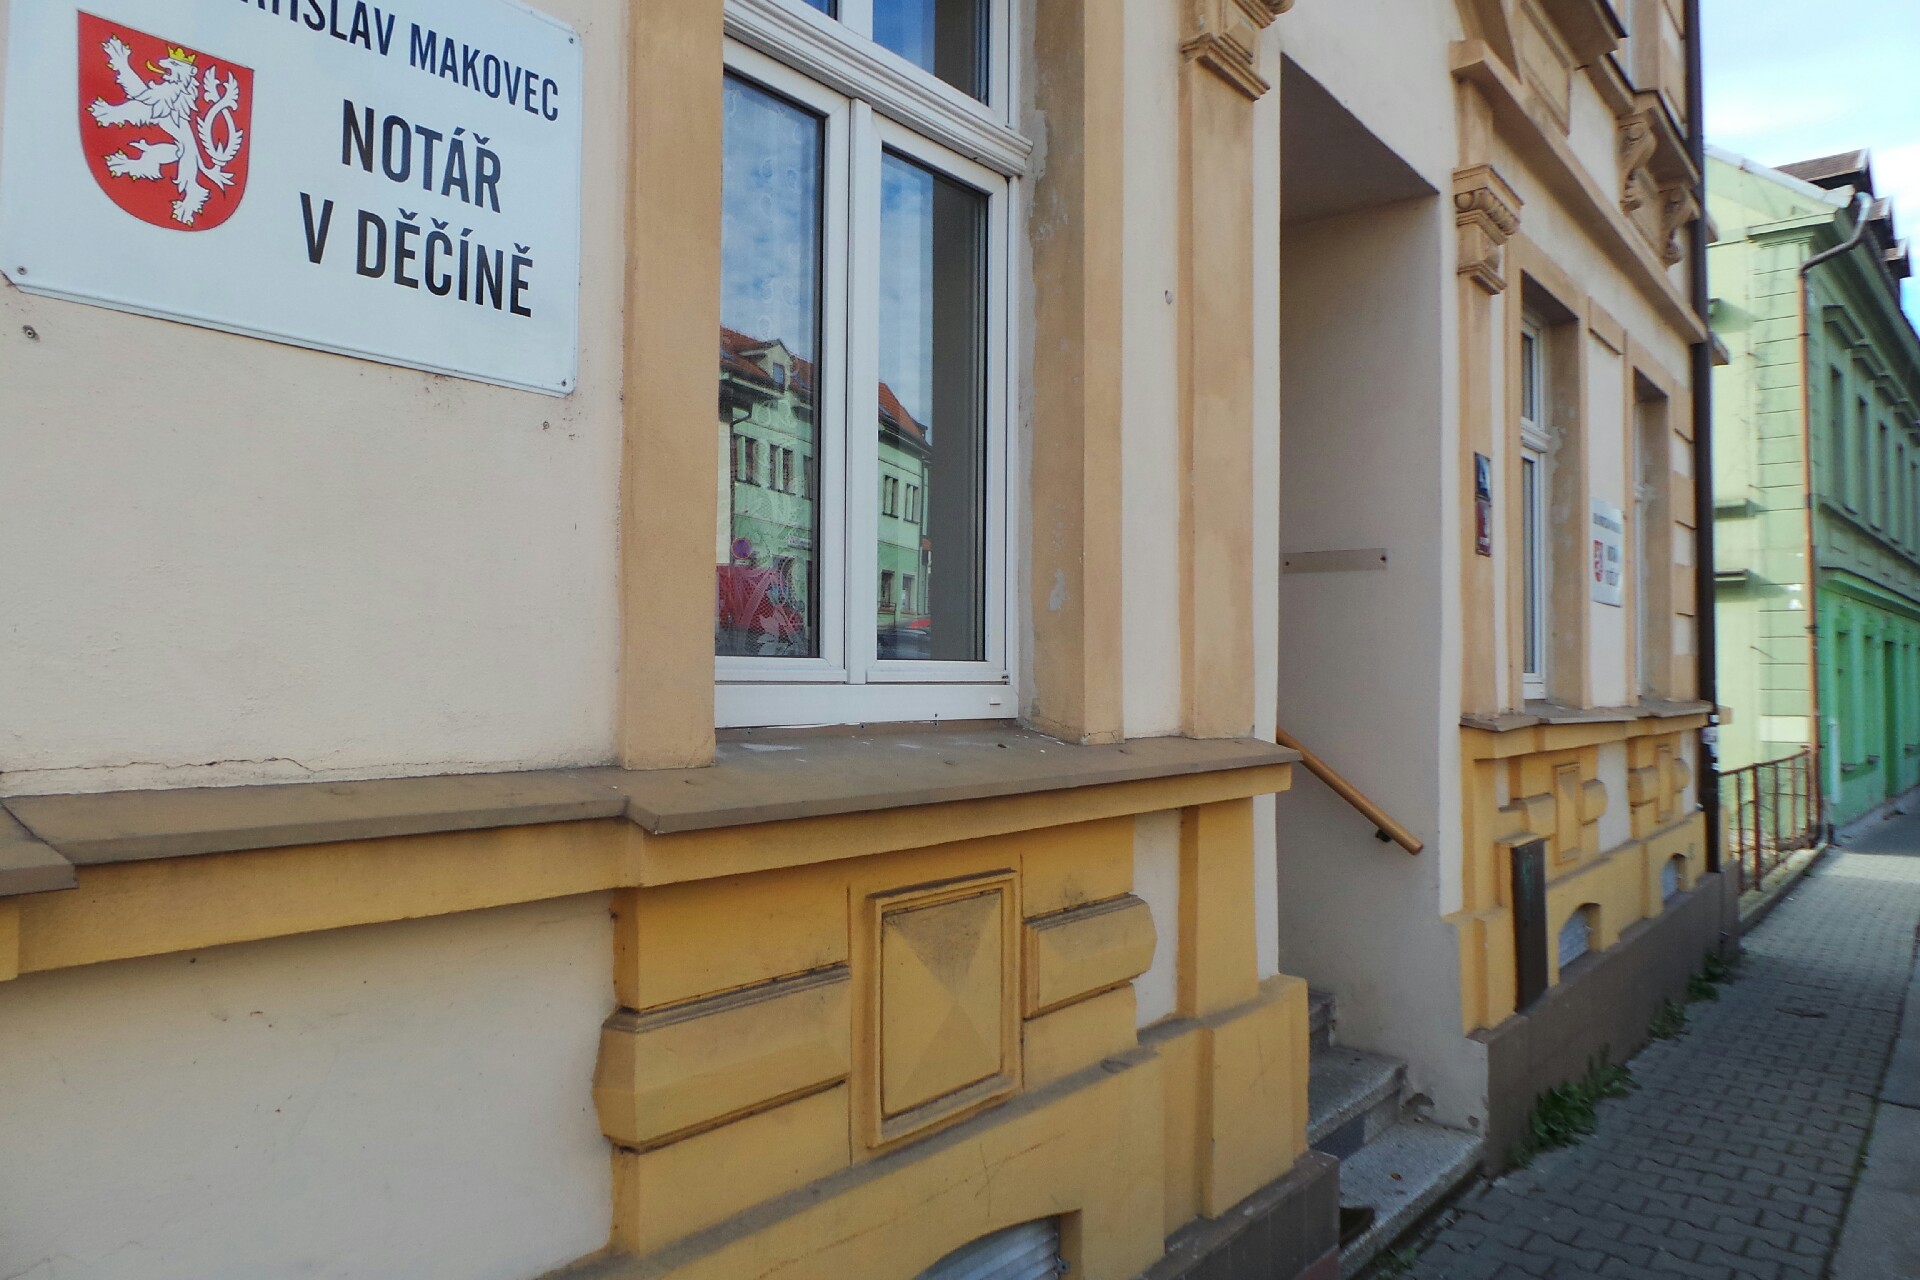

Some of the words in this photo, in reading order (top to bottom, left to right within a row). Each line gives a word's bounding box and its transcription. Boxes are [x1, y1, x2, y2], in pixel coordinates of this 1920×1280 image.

[410, 22, 559, 122] MAKOVEC
[342, 98, 502, 214] NOTÁŘ
[299, 191, 334, 265] V
[356, 207, 534, 319] DĚČÍNĚ
